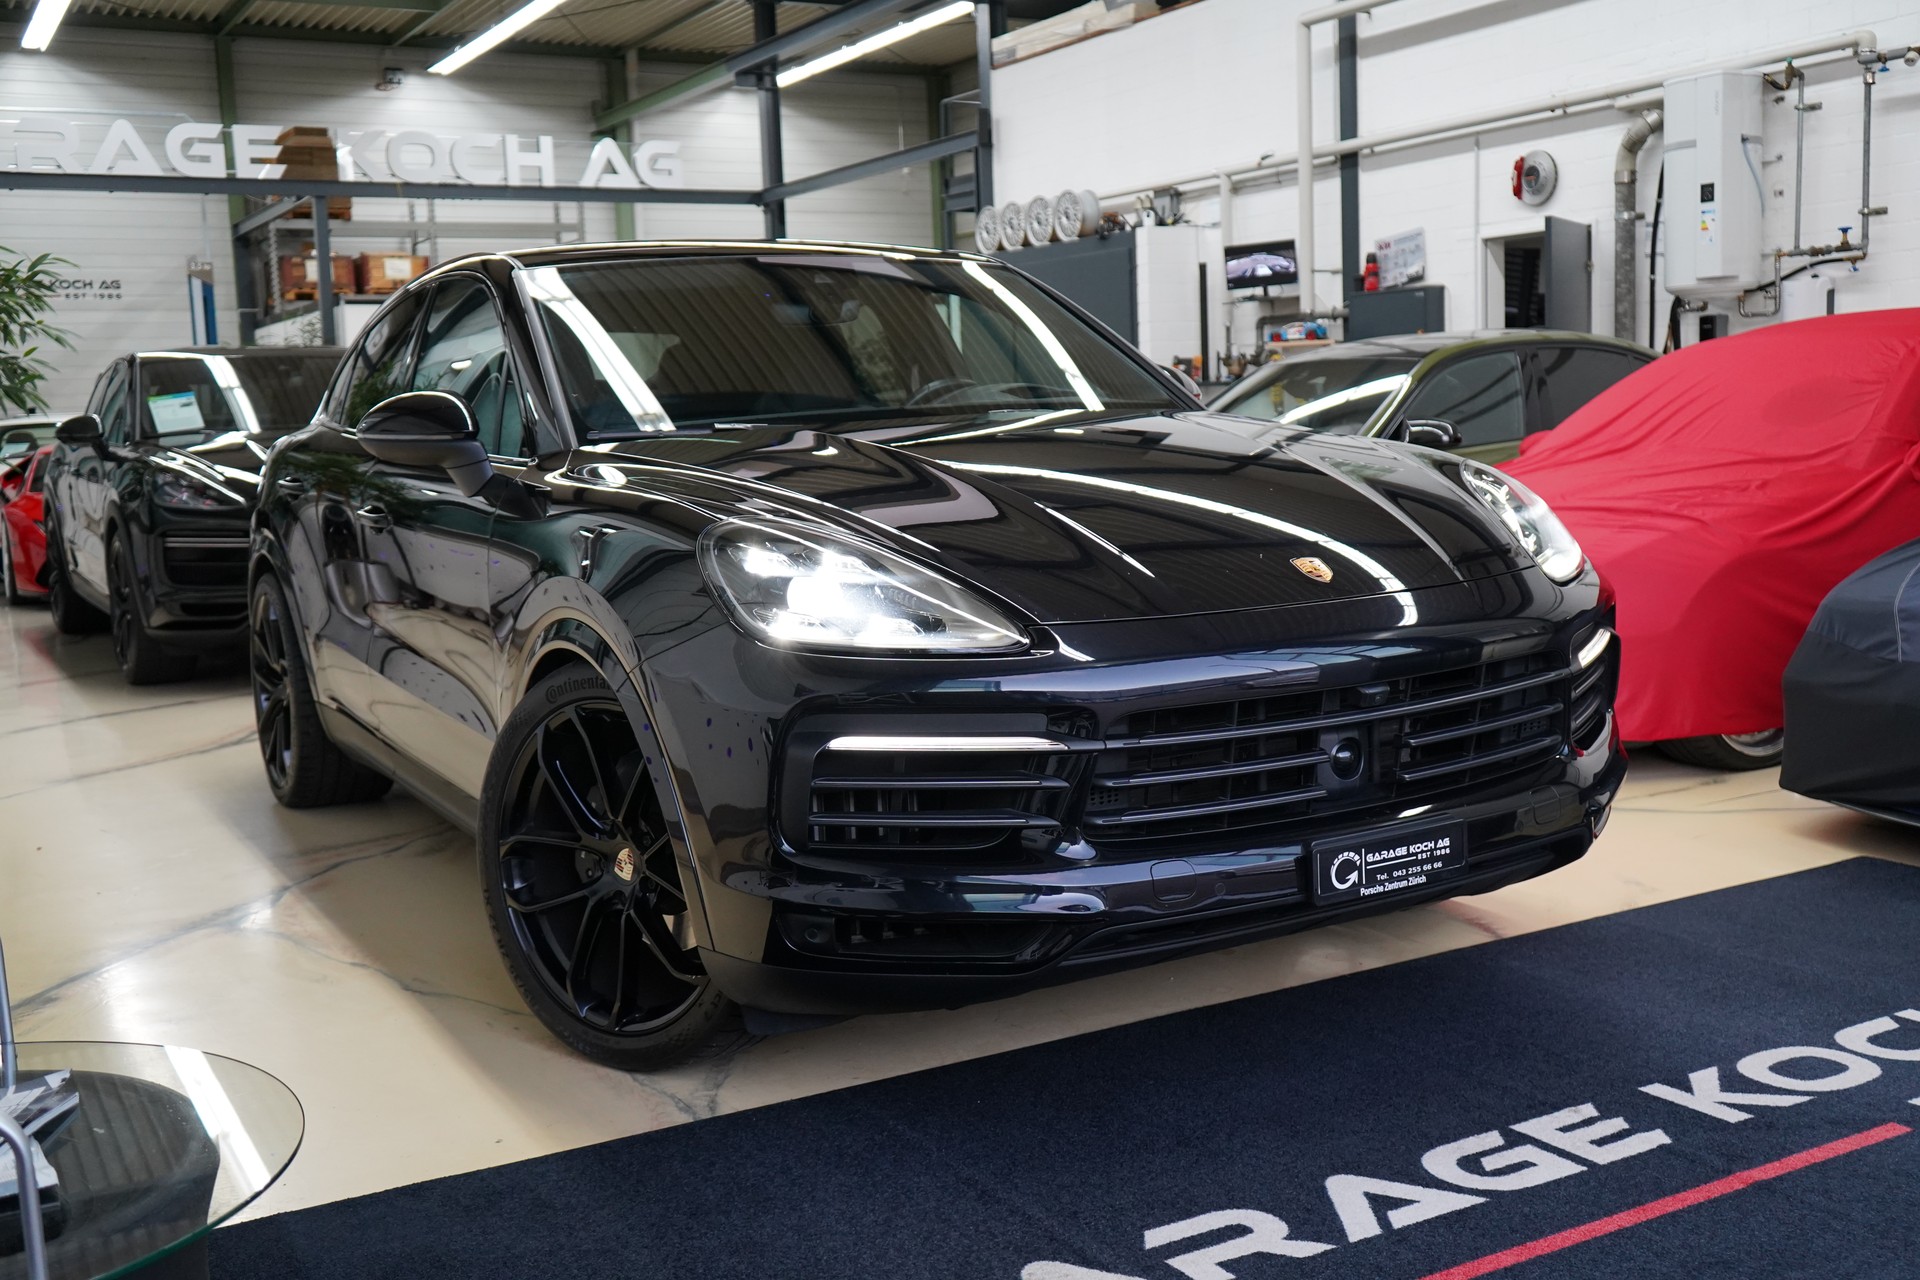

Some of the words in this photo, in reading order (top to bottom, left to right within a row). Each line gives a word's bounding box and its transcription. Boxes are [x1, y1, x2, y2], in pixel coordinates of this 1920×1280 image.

[14, 117, 288, 179] RAGE
[336, 128, 556, 187] KOCH
[578, 137, 684, 189] AG
[98, 279, 121, 289] AG
[1366, 846, 1408, 862] GARAGE
[1409, 841, 1434, 854] KOCH
[1436, 837, 1450, 848] AG
[1417, 852, 1431, 860] EST
[1433, 848, 1450, 857] 1986
[1376, 873, 1389, 881] Tel.
[1393, 869, 1406, 878] 043
[1408, 866, 1421, 874] 255
[1423, 863, 1432, 871] 66
[1433, 861, 1442, 869] 66
[1360, 884, 1384, 897] Porsche
[1384, 880, 1408, 891] Zentrum
[1408, 874, 1427, 886] Zürich
[1020, 1102, 1673, 1280] RAGE
[1637, 1008, 1920, 1123] KOC
